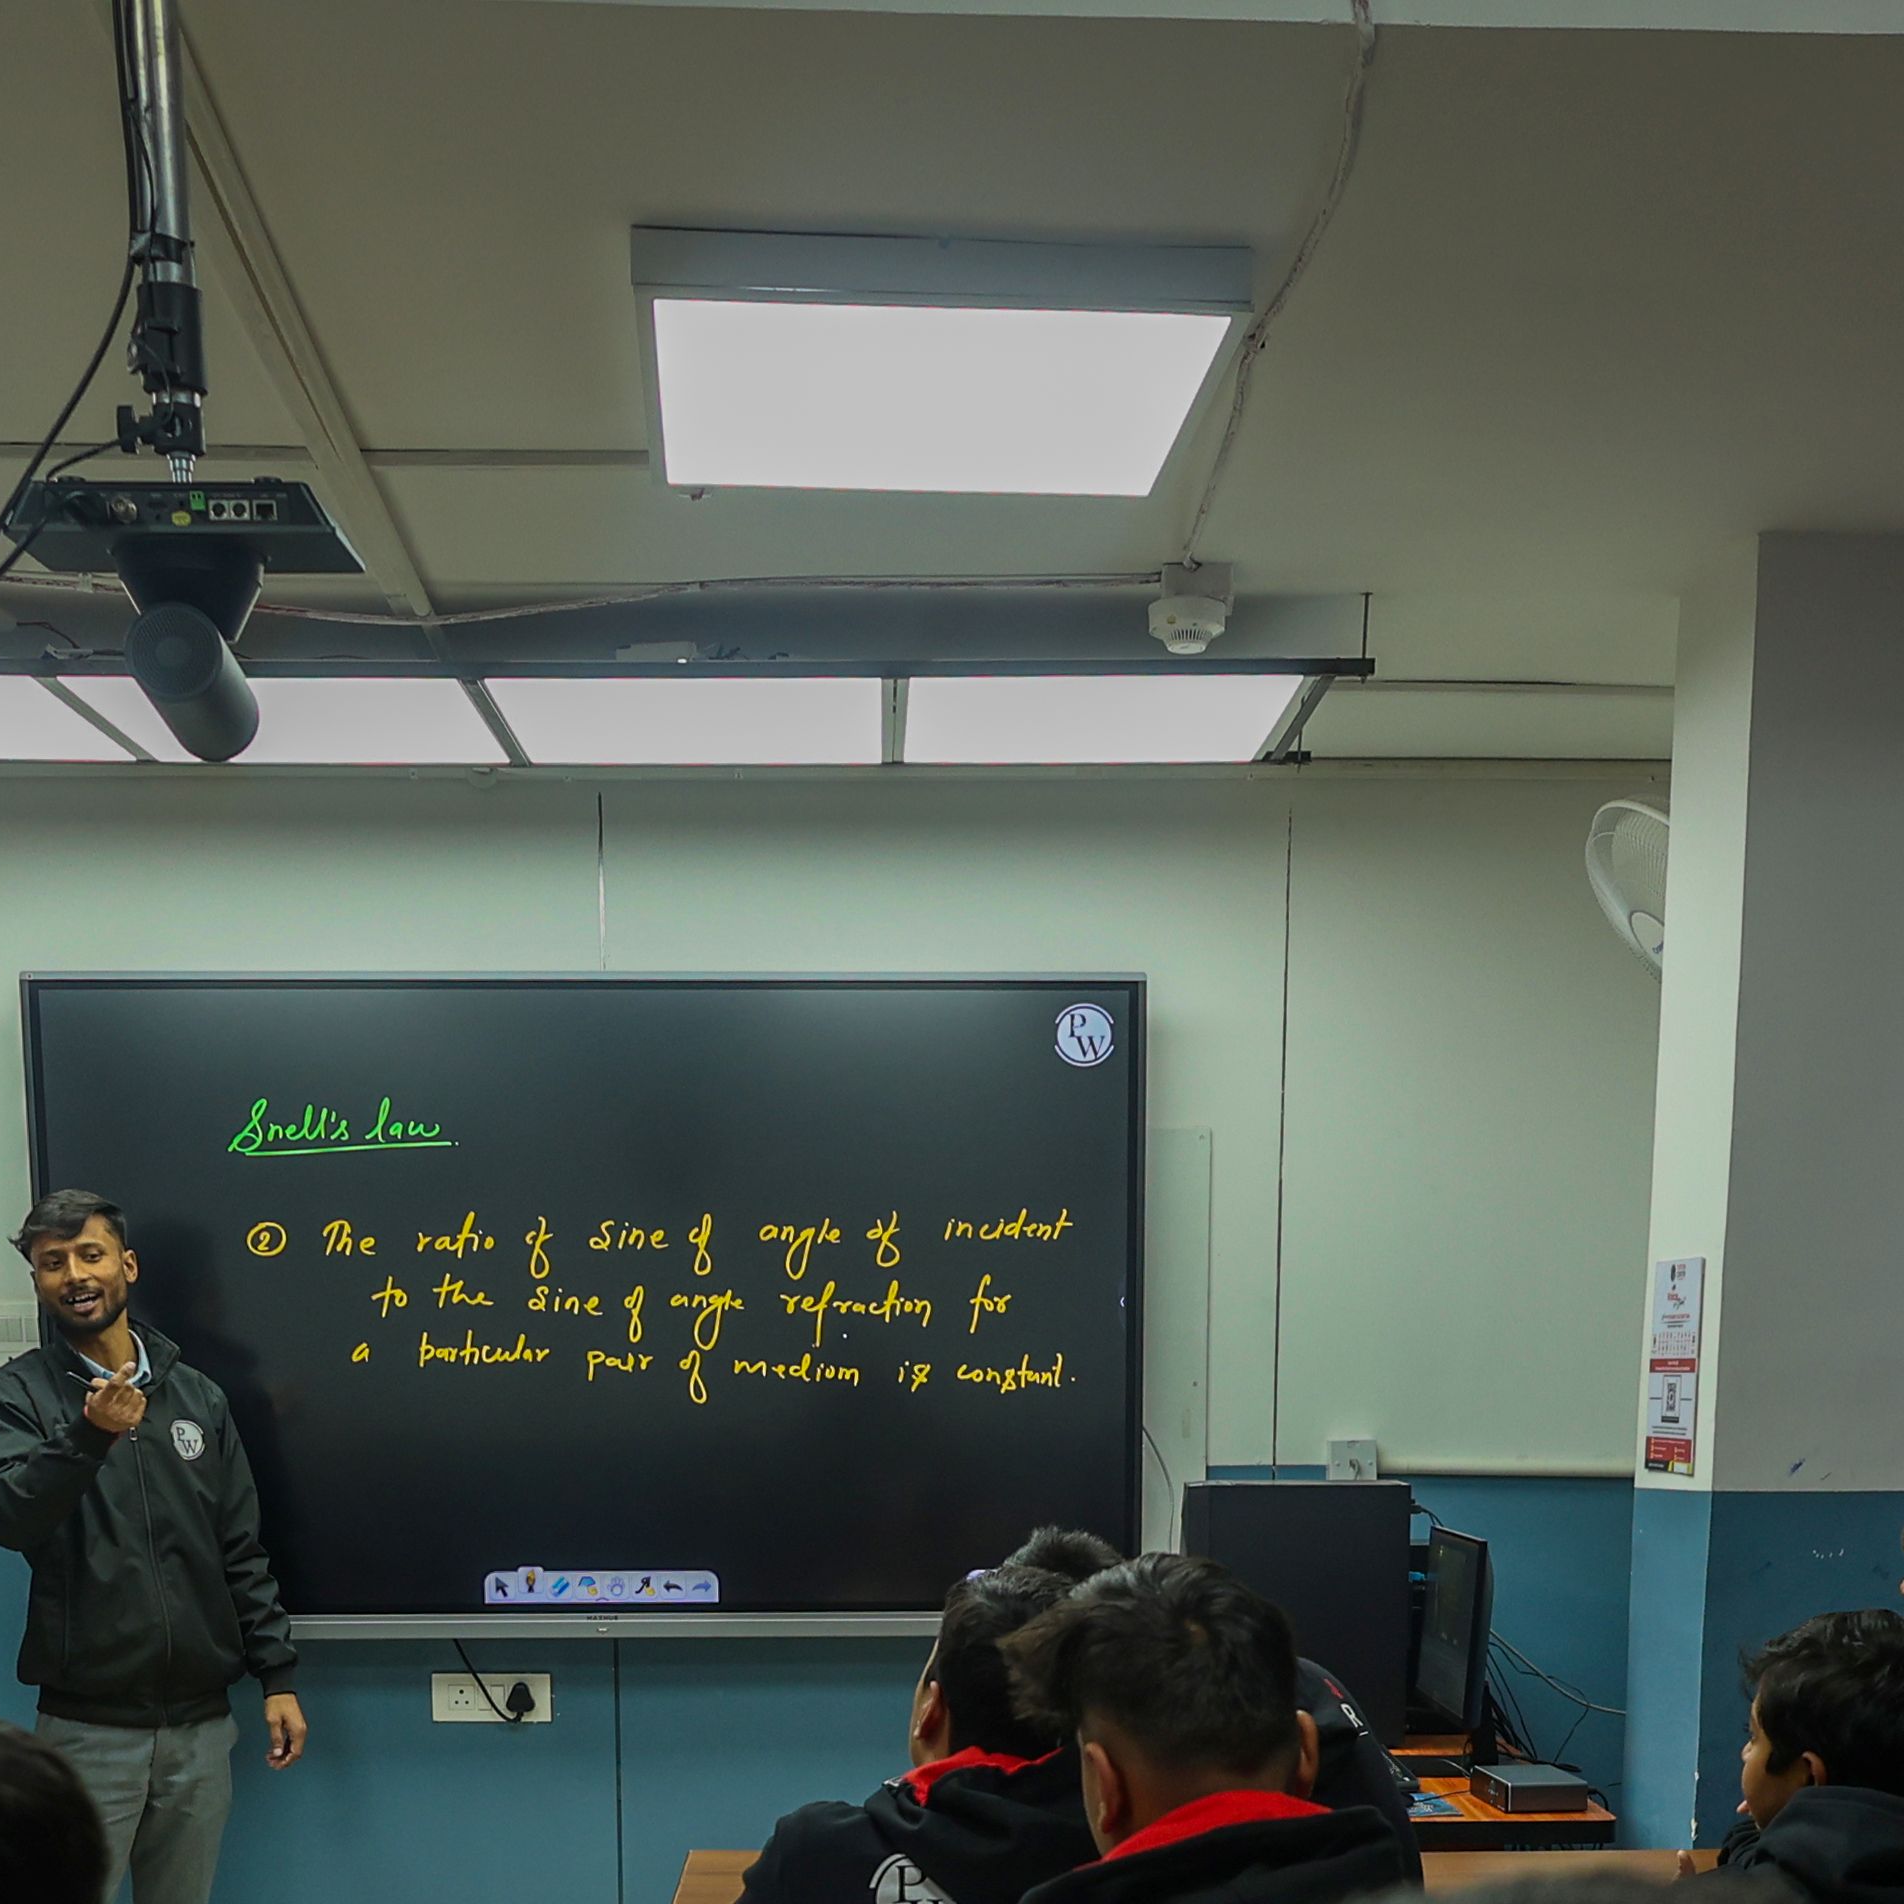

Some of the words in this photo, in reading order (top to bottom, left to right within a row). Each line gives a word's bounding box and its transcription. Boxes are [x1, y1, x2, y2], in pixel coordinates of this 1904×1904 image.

[227, 1097, 350, 1153] Snell's
[323, 1219, 377, 1257] The
[416, 1211, 496, 1258] ratio
[525, 1216, 553, 1279] of
[688, 1212, 714, 1276] of
[759, 1217, 842, 1281] angle
[865, 1210, 902, 1268] of
[943, 1207, 1074, 1241] incident
[371, 1275, 409, 1318] to
[432, 1272, 494, 1309] the
[623, 1285, 646, 1343] of
[669, 1289, 745, 1352] angle
[780, 1279, 934, 1348] refraction
[969, 1273, 1013, 1334] for
[350, 1342, 371, 1362] a
[418, 1329, 551, 1368] particular
[679, 1349, 707, 1405] of
